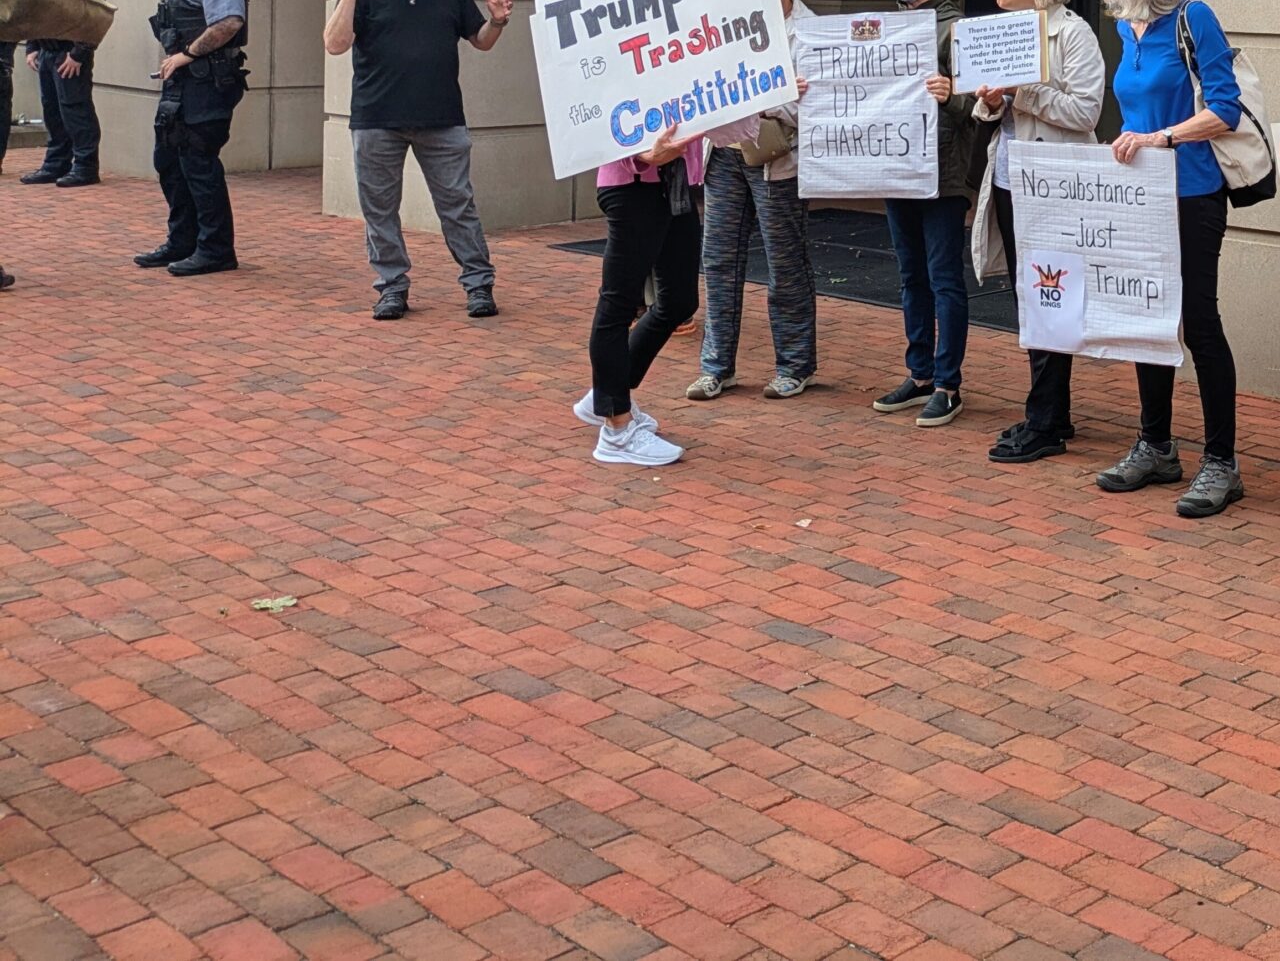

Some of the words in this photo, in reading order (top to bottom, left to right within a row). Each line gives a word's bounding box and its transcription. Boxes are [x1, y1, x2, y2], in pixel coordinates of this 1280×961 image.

[1008, 20, 1034, 30] greater
[963, 42, 983, 51] which
[992, 37, 1035, 49] perpetrated
[973, 33, 1000, 42] tyranny
[579, 56, 607, 80] is
[618, 9, 770, 75] Trashing
[969, 50, 990, 59] under
[1005, 46, 1026, 54] shield
[813, 43, 919, 80] TRUMPED
[984, 57, 998, 65] law
[1000, 55, 1014, 63] and
[1011, 61, 1034, 71] justice
[833, 85, 867, 118] UP
[569, 103, 603, 126] the
[1021, 168, 1050, 198] No
[1058, 172, 1147, 206] substance
[1089, 263, 1159, 310] Trump
[1040, 288, 1061, 301] NO
[1040, 301, 1062, 309] KINGS
